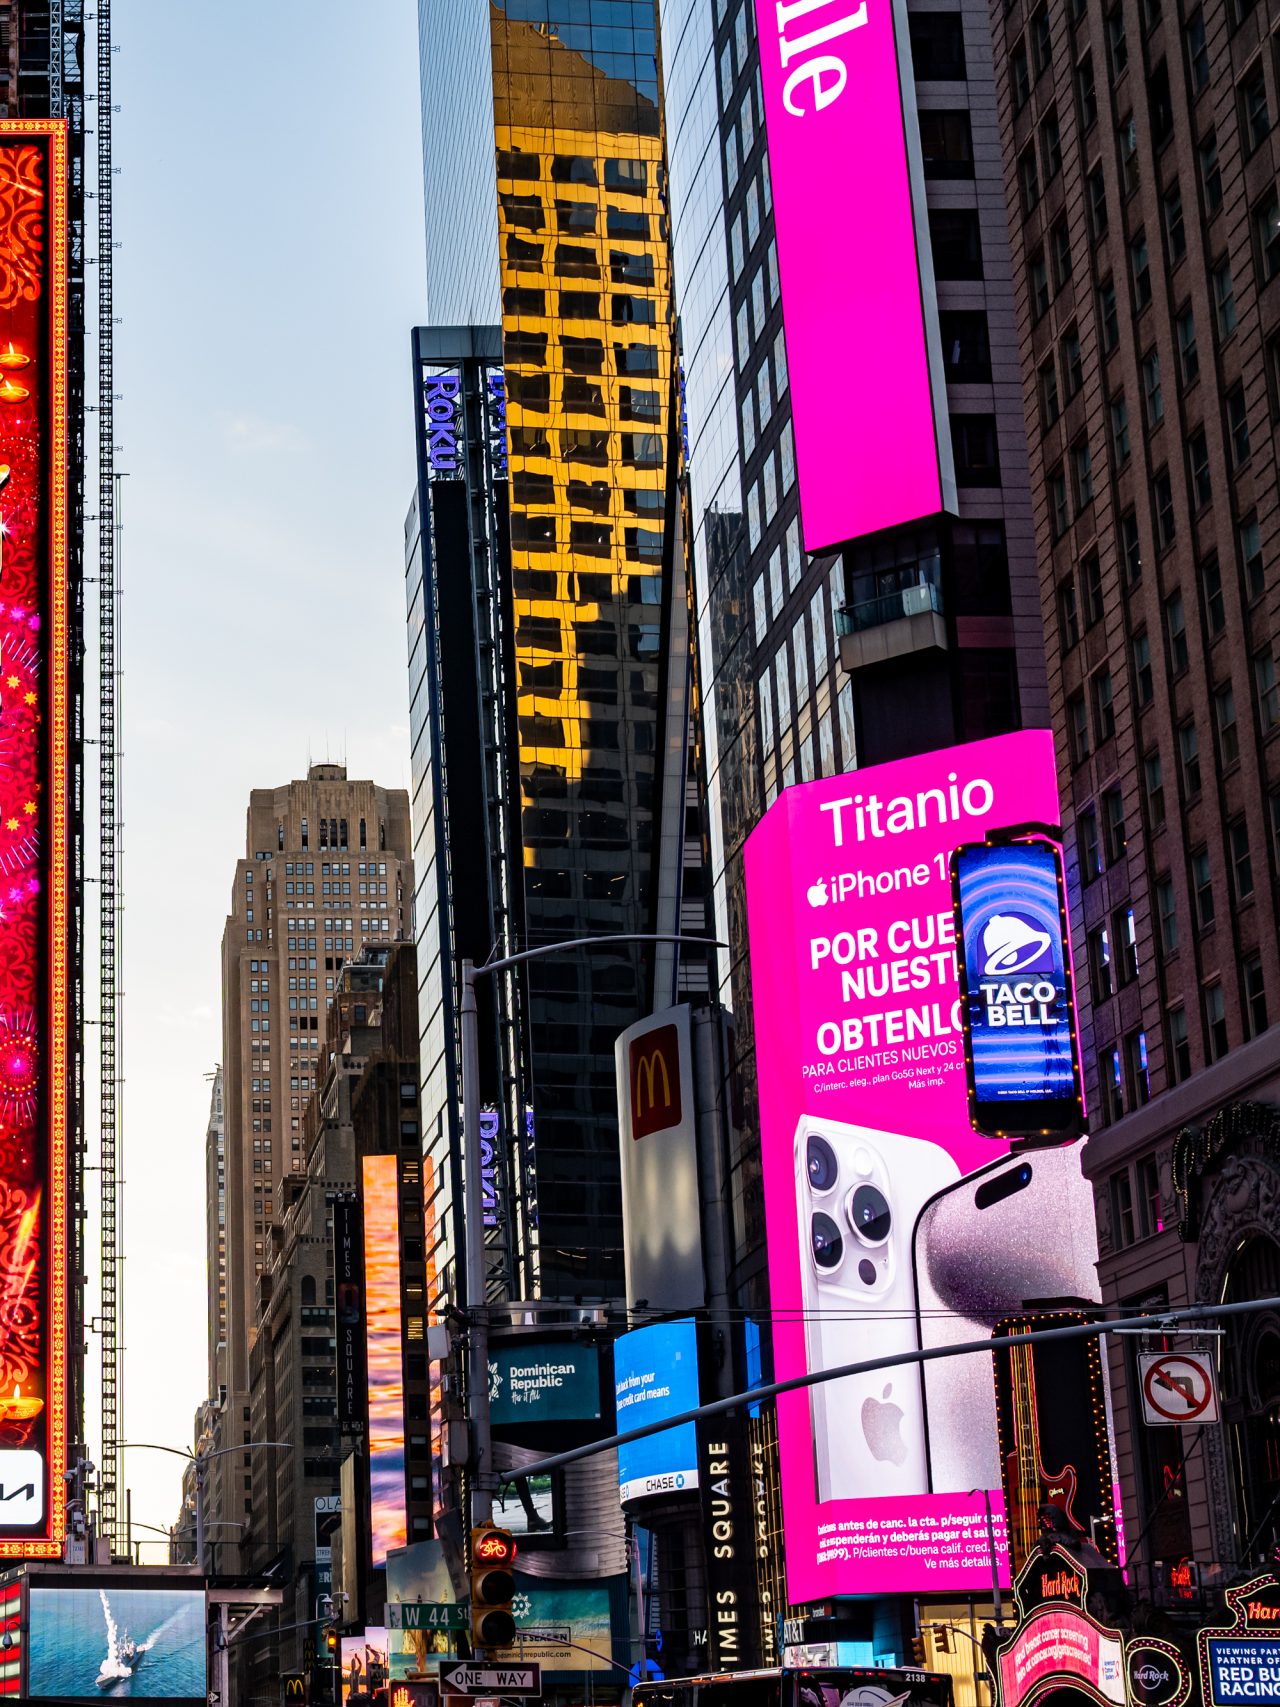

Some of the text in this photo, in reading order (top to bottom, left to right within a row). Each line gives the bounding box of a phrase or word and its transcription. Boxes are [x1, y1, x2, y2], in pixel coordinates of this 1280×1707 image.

[820, 772, 995, 847] Titanio
[831, 850, 953, 904] iPhone 1
[810, 927, 880, 970] POR
[841, 950, 960, 1003] NUEST
[980, 982, 1055, 1004] TACO
[988, 1004, 1057, 1026] BELL
[802, 1040, 957, 1079] PARA CLIENTES NUEVOS
[872, 1073, 890, 1086] plan
[892, 1068, 915, 1080] Go5G
[916, 1064, 935, 1076] Next
[944, 1062, 955, 1072] 24
[908, 1077, 945, 1090] Más imp.
[343, 1208, 352, 1277] TIMES
[346, 1329, 354, 1415] SQUARE
[510, 1363, 575, 1378] Dominican
[511, 1375, 563, 1391] Republic
[647, 1386, 670, 1400] means
[646, 1476, 674, 1492] CHASE
[709, 1443, 734, 1558] SQUARE
[838, 1520, 864, 1531] antes
[866, 1518, 878, 1530] de
[880, 1519, 907, 1529] canc.
[908, 1516, 918, 1527] la
[919, 1516, 939, 1527] cta.
[940, 1513, 982, 1527] p/seguir
[890, 1530, 929, 1542] deberás
[931, 1530, 960, 1542] pagar
[962, 1528, 971, 1538] el
[973, 1527, 1001, 1538] salo
[853, 1547, 898, 1559] P/clientes
[900, 1544, 939, 1557] c/buena
[941, 1542, 963, 1554] calif.
[965, 1541, 990, 1553] cred.
[924, 1558, 937, 1568] Ve
[939, 1557, 959, 1568] más
[1041, 1571, 1081, 1599] Hard Rock
[406, 1608, 467, 1626] W 44 St
[718, 1591, 739, 1671] IMES
[784, 1620, 804, 1644] AT&T
[1216, 1648, 1257, 1656] VIEWING
[1217, 1656, 1263, 1664] PARTNER
[455, 1672, 526, 1686] ONE WAY
[905, 1673, 926, 1683] 2138
[1133, 1670, 1169, 1681] Hard Rock
[1218, 1667, 1254, 1681] RED
